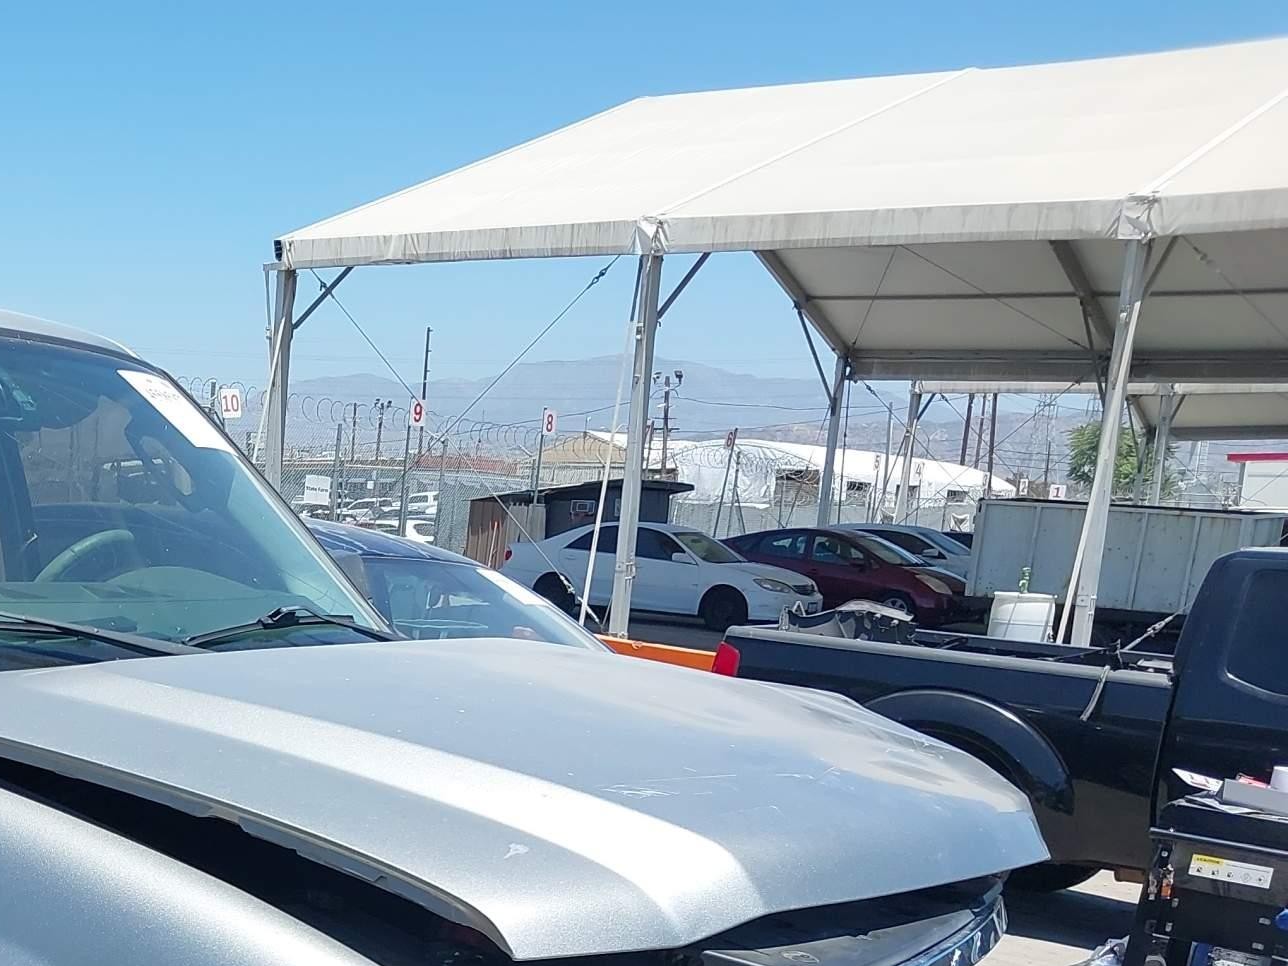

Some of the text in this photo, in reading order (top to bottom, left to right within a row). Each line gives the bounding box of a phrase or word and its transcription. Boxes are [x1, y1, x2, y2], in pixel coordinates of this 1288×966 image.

[222, 394, 240, 413] 10
[413, 403, 423, 423] 9
[545, 414, 554, 432] 8
[726, 431, 733, 448] 6
[874, 455, 880, 469] 5
[915, 463, 922, 478] 4
[1020, 480, 1027, 494] 2
[1053, 486, 1061, 498] 1
